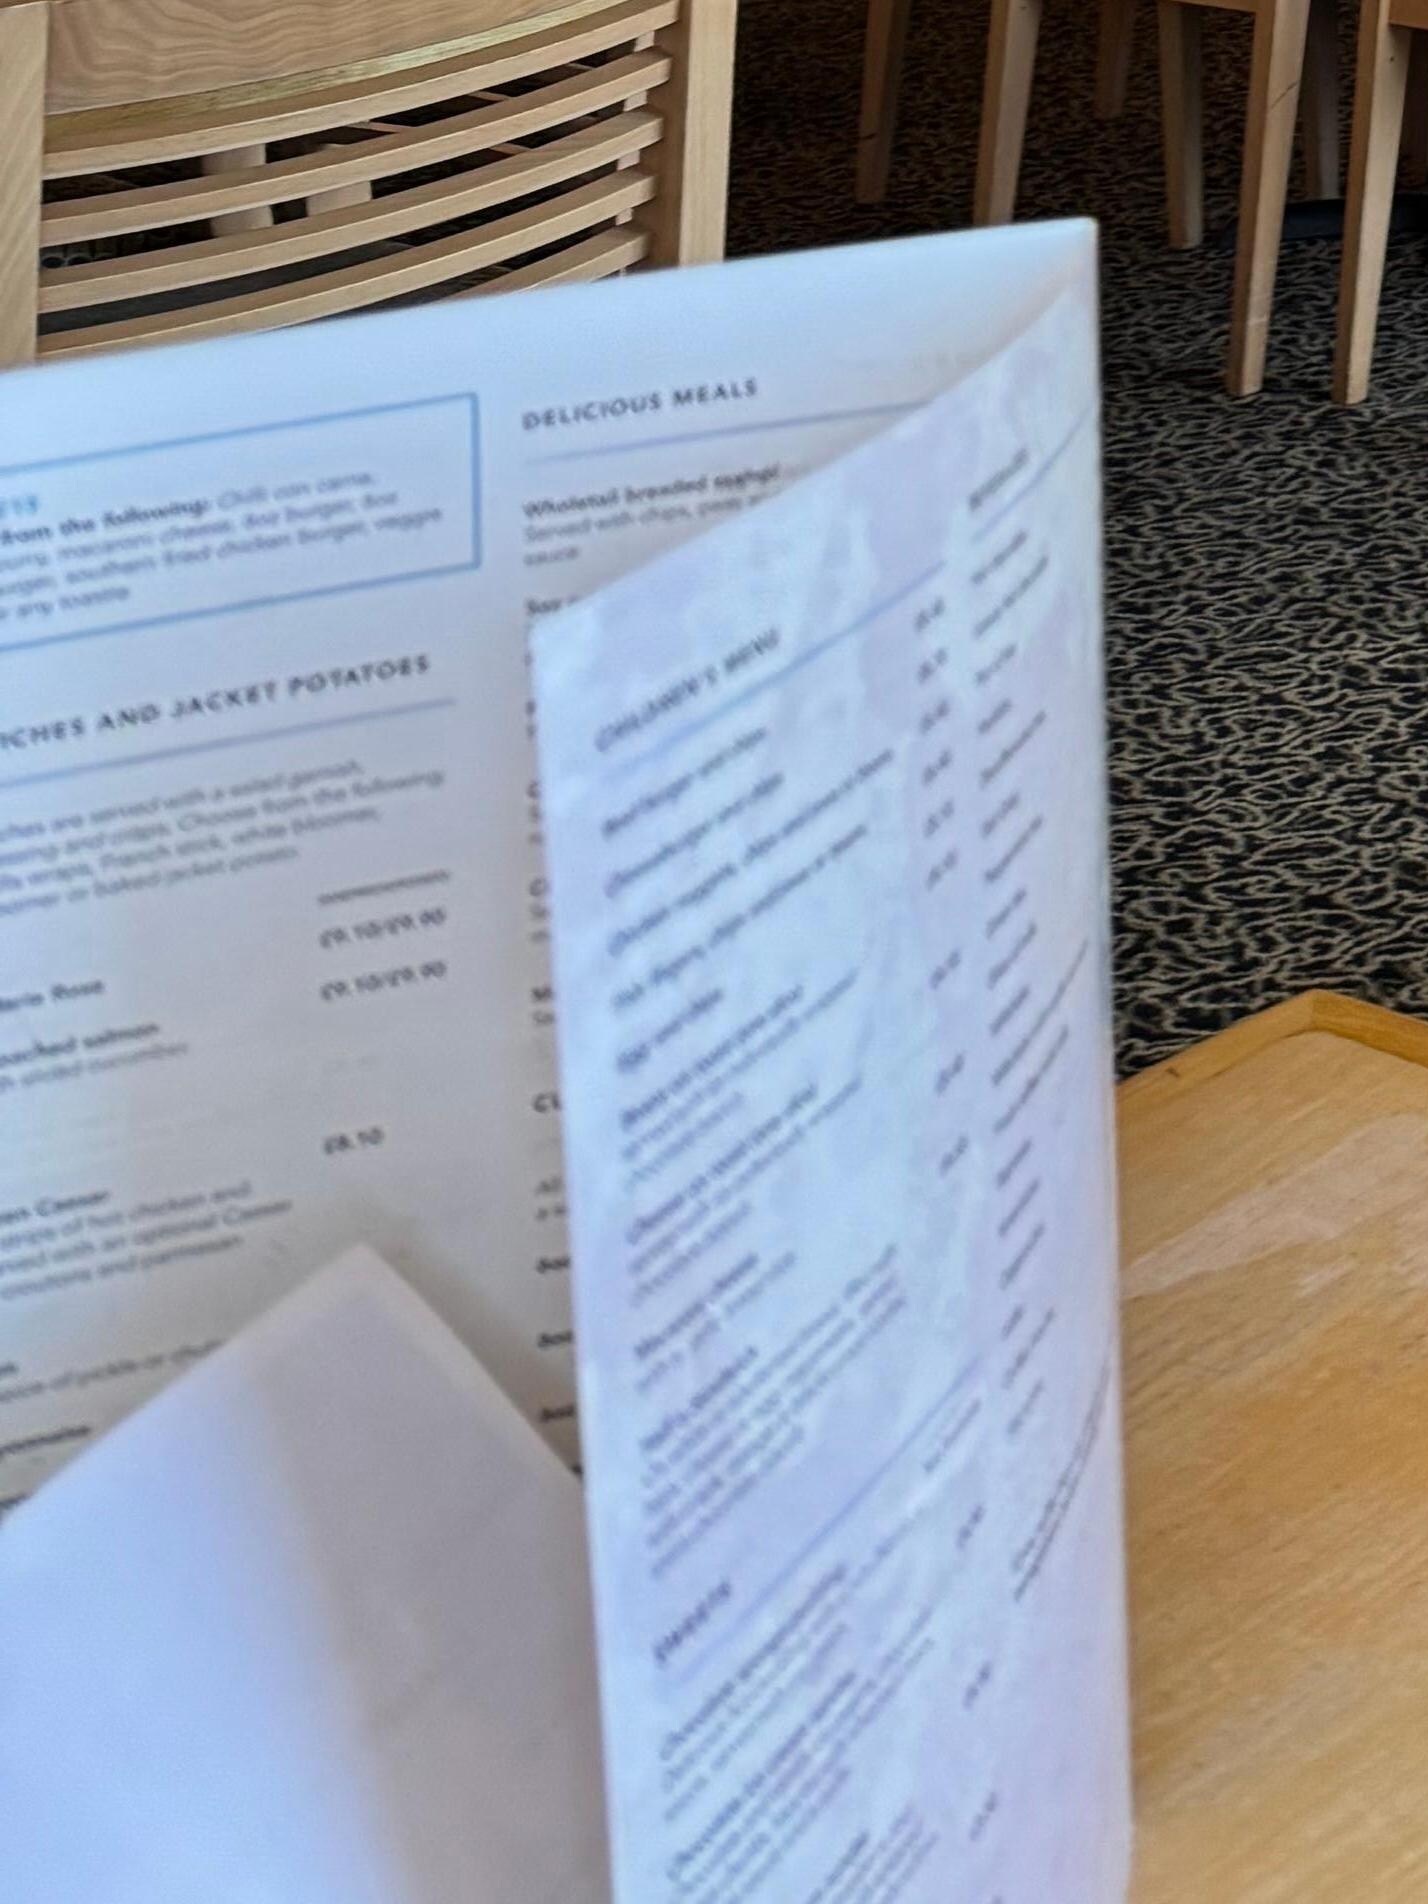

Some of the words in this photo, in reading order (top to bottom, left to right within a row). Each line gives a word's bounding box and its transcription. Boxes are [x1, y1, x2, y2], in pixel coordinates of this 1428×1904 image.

[521, 392, 662, 432] DELICIOUS
[672, 376, 758, 408] MEALS
[723, 626, 781, 675] MENU
[97, 702, 162, 733] AND
[170, 680, 279, 720] JACKET
[288, 652, 432, 698] POTATOES
